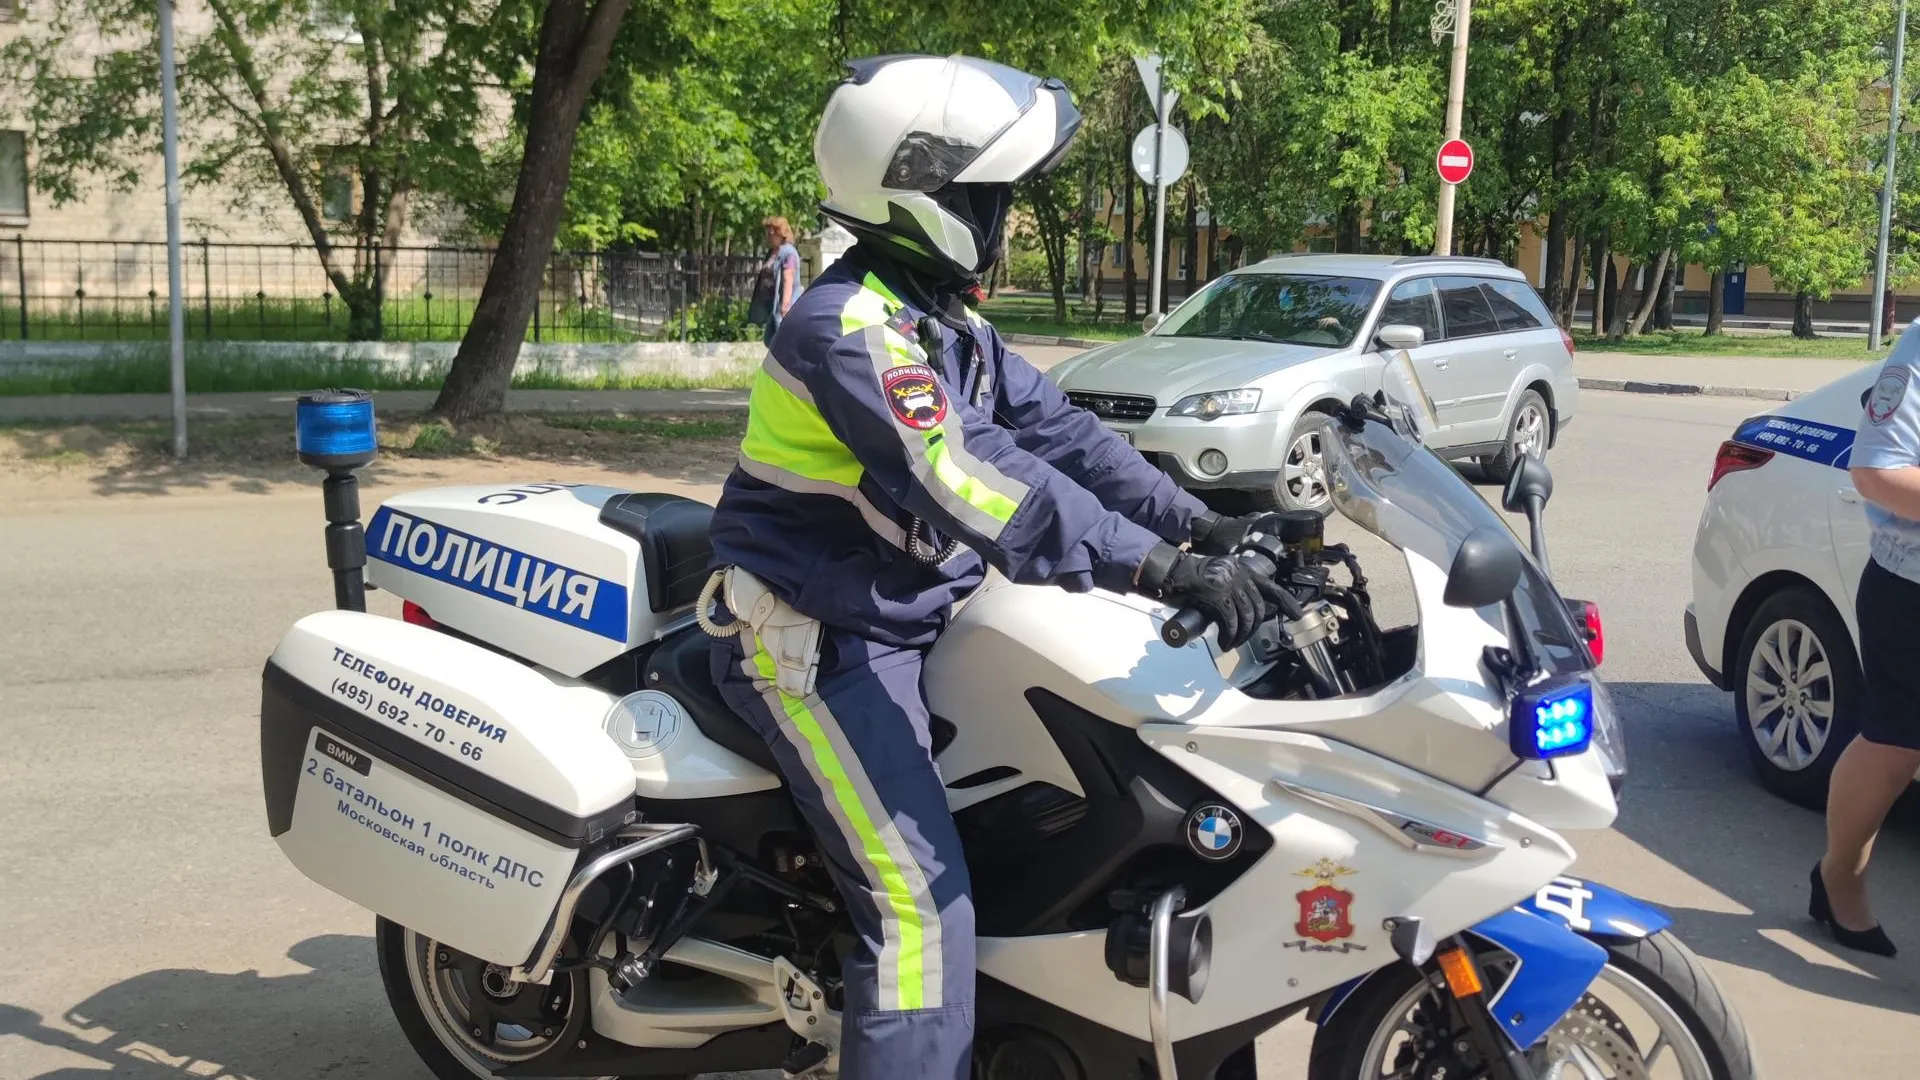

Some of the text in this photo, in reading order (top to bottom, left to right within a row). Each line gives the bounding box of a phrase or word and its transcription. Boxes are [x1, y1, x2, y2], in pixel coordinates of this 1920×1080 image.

[380, 513, 600, 621] ПОЛИЦИЯ
[331, 678, 372, 711] (495)
[377, 700, 410, 729] 692
[424, 723, 446, 747] 70
[459, 742, 484, 764] 66
[334, 648, 508, 745] ТЕЛЕФОН ДОВЕРИЯ
[326, 742, 357, 766] BMW
[306, 757, 545, 890] 2 батальон 1 полк ДПС
[336, 799, 497, 890] Московская область
[1195, 808, 1239, 828] BMW
